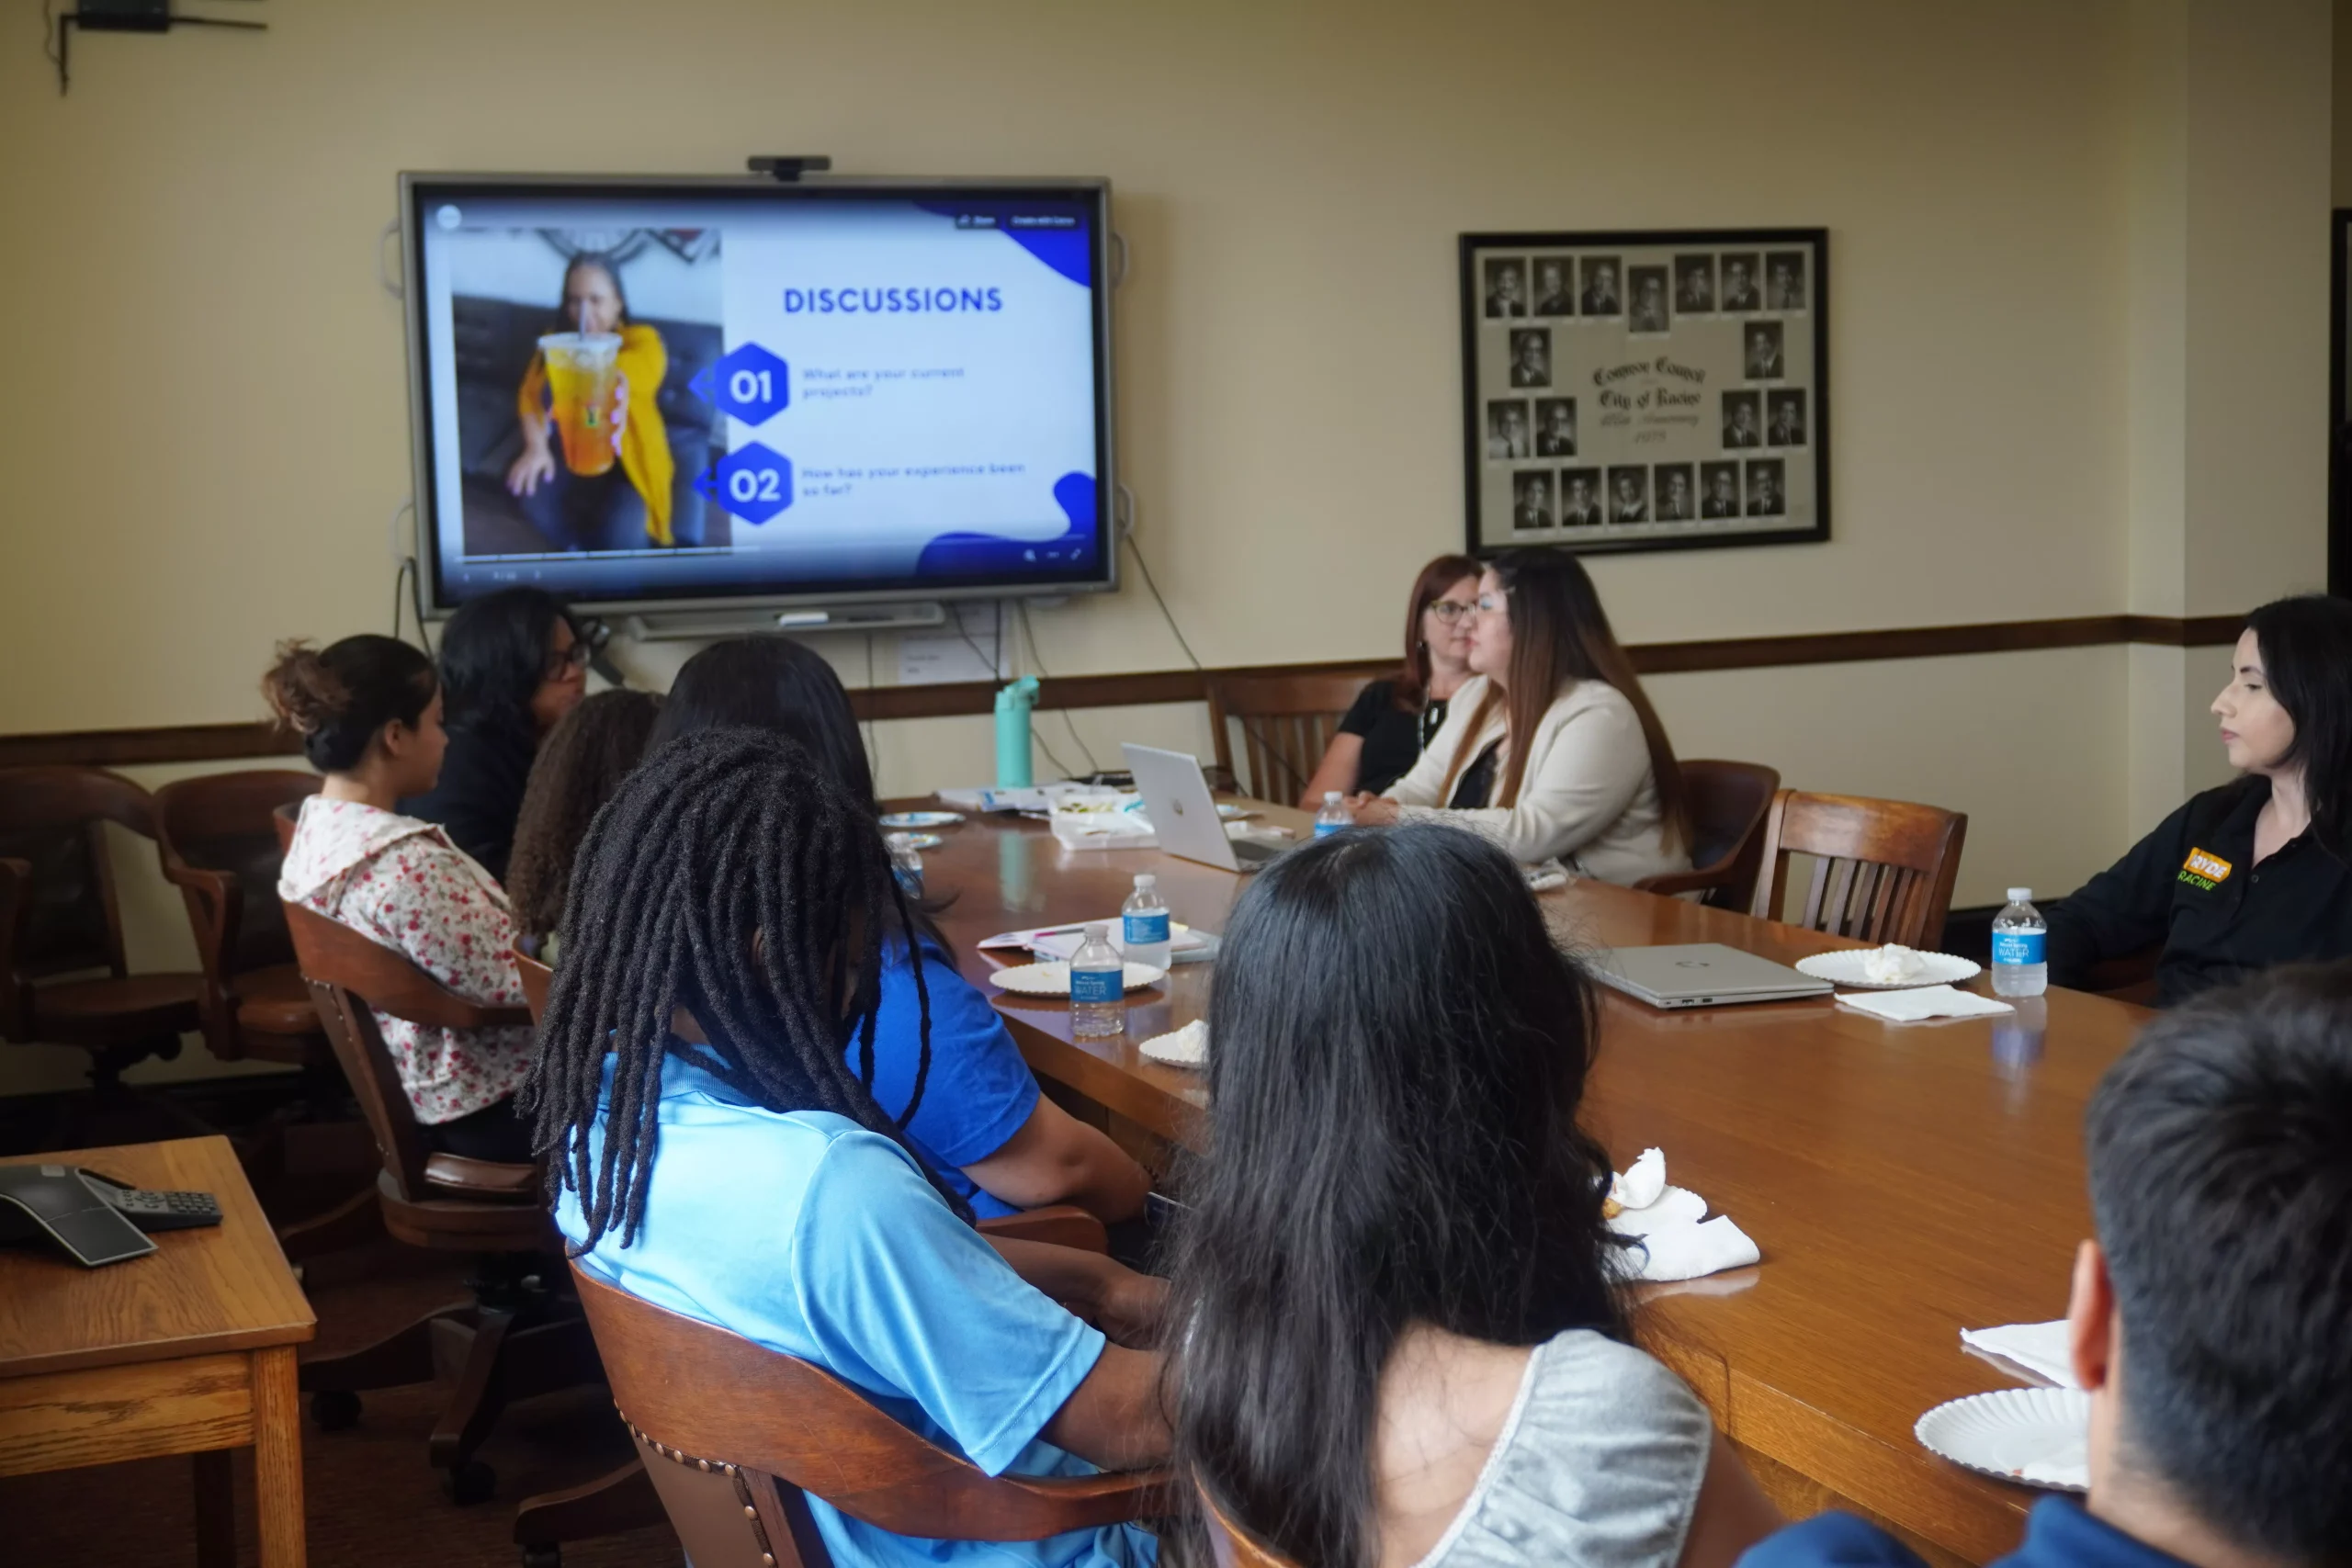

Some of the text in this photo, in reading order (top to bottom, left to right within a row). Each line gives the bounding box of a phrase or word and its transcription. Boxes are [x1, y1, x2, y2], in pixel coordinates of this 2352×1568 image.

[785, 287, 1003, 314] DISCUSSIONS
[802, 367, 965, 382] What are your current
[1592, 355, 1706, 386] Common Council
[729, 369, 773, 404] 01
[802, 382, 873, 400] projects?
[1600, 386, 1702, 411] City of Racine
[801, 462, 1027, 479] How has your experience been
[729, 468, 781, 502] 02
[802, 482, 853, 497] so far?
[2189, 853, 2228, 879] RYDE
[2177, 870, 2217, 891] RACINE
[1998, 947, 2030, 958] WATER
[1075, 985, 1107, 995] WATER
